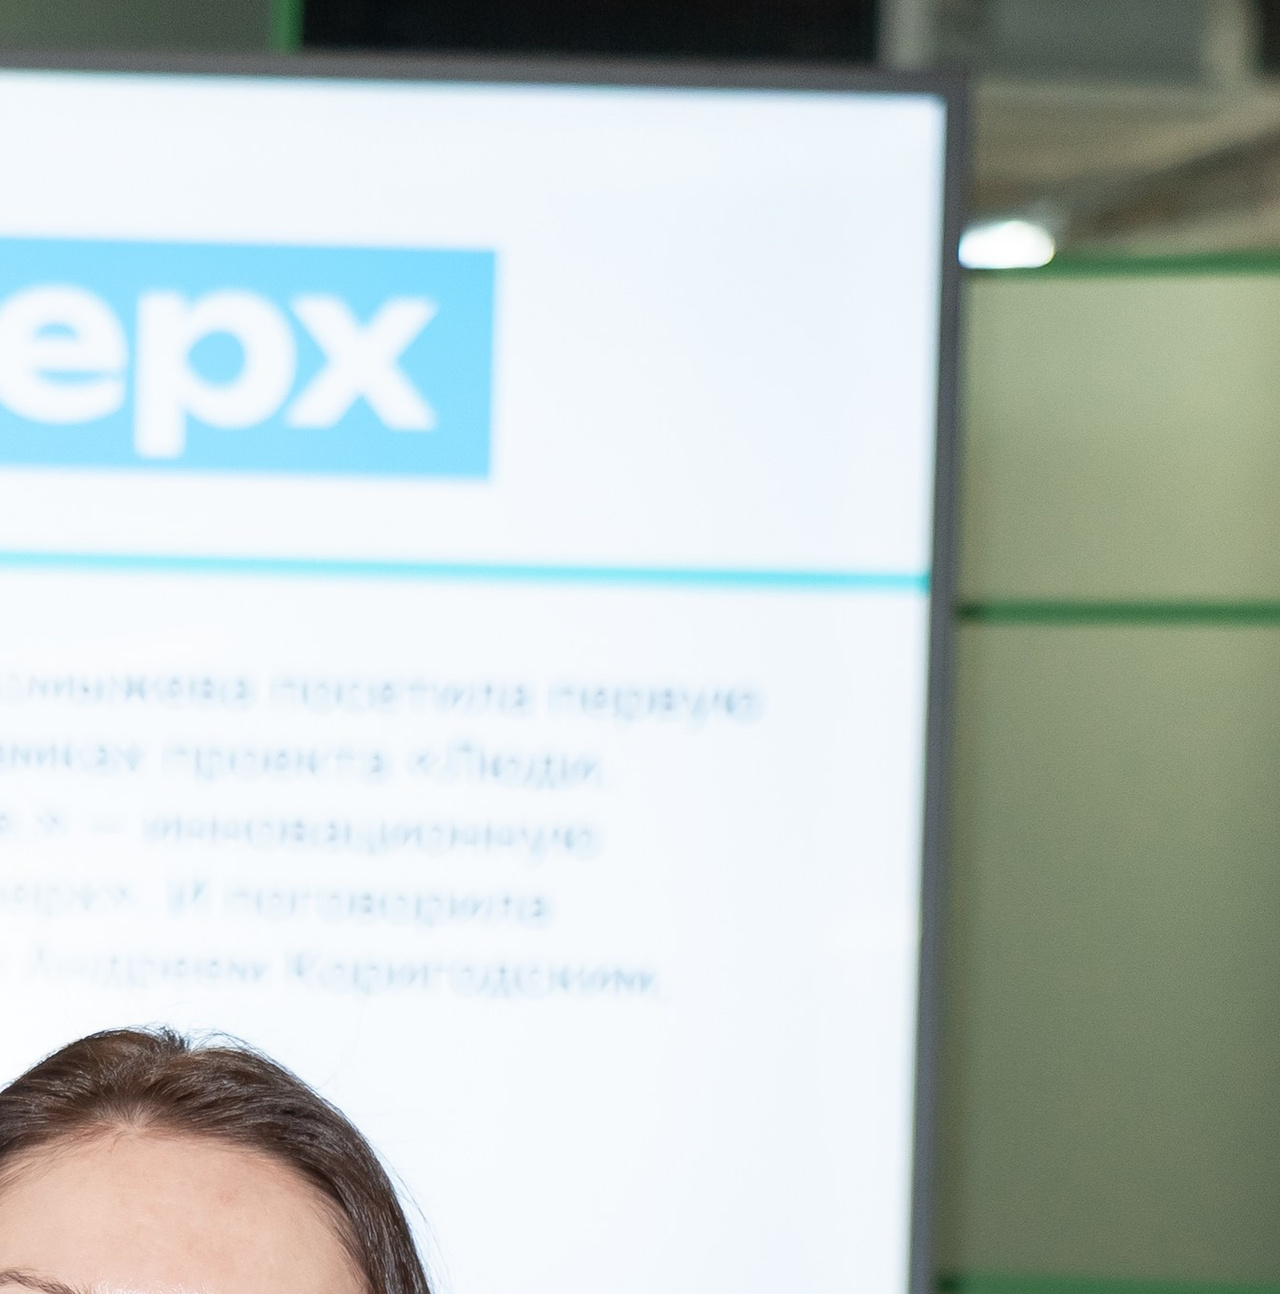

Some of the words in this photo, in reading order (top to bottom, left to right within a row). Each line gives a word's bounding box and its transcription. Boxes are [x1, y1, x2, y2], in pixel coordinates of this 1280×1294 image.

[269, 670, 537, 719] посетила
[549, 674, 764, 729] первую
[165, 738, 392, 786] проекта
